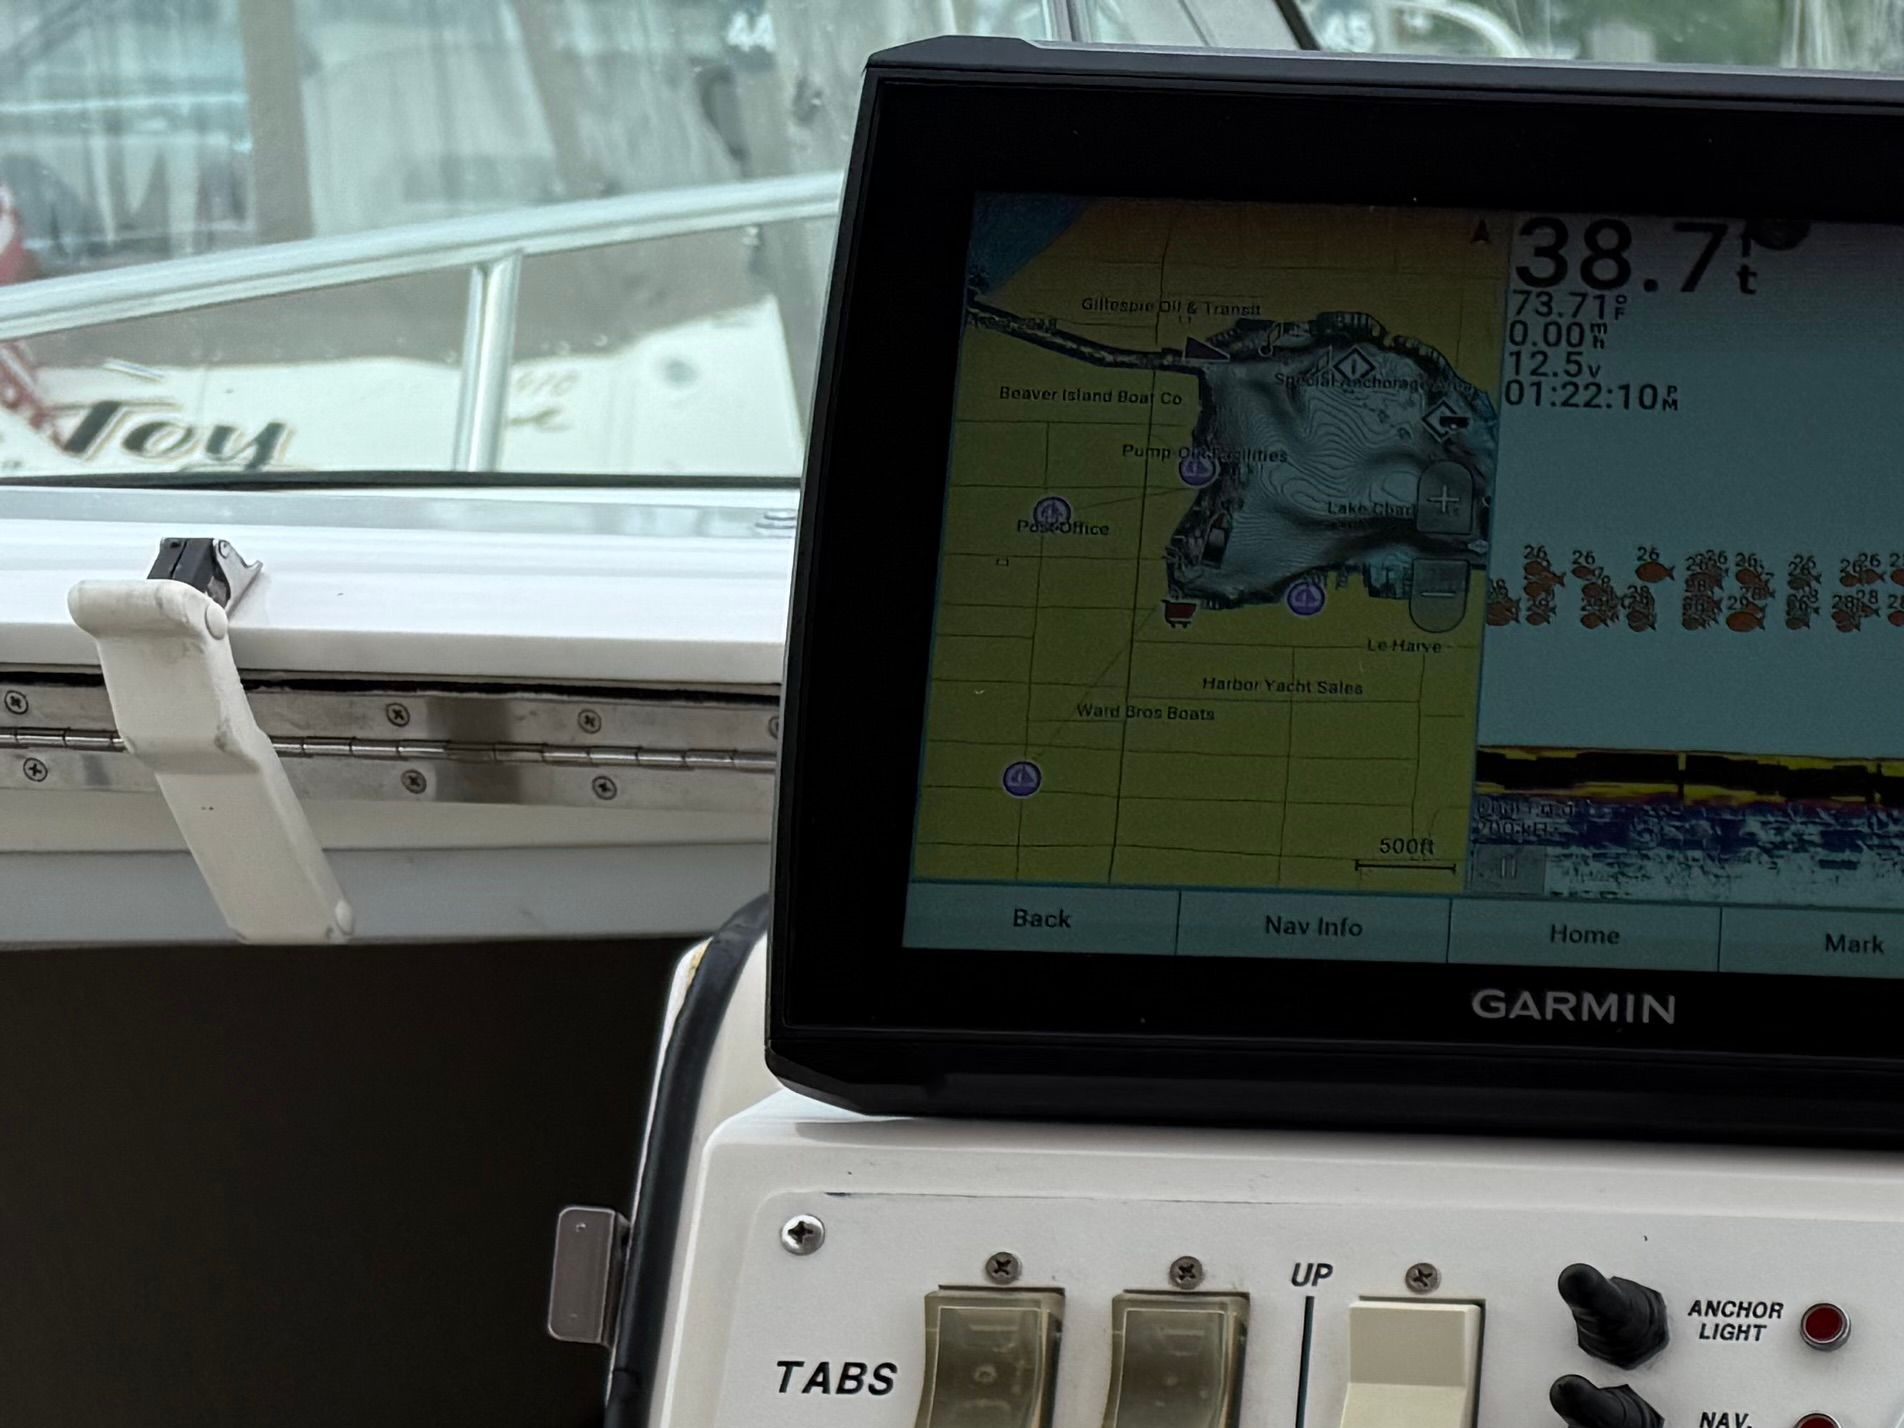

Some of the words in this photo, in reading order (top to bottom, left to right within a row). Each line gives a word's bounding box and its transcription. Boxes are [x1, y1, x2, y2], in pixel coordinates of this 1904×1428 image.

[1513, 214, 1728, 297] 38.7
[1203, 301, 1261, 317] Transit
[998, 385, 1057, 402] Beaver
[1061, 386, 1113, 404] Island
[1118, 388, 1154, 405] Boat
[1158, 391, 1182, 406] Co
[1202, 677, 1260, 693] Harbor
[1263, 679, 1313, 695] Yacht
[1316, 681, 1363, 697] Sales
[1077, 703, 1120, 721] Ward
[1124, 704, 1162, 723] Bros
[1167, 705, 1215, 724] Boats
[1379, 837, 1435, 858] 500ft
[1013, 908, 1072, 931] Back
[1264, 914, 1310, 937] Nav
[1317, 915, 1363, 939] Info
[1550, 923, 1621, 947] Home
[1824, 932, 1884, 956] Mark
[1471, 987, 1676, 1025] GARMIN
[1291, 1262, 1333, 1291] UP
[1687, 1299, 1785, 1320] ANCHOR
[1698, 1323, 1767, 1342] LIGHT
[773, 1358, 898, 1400] TABS
